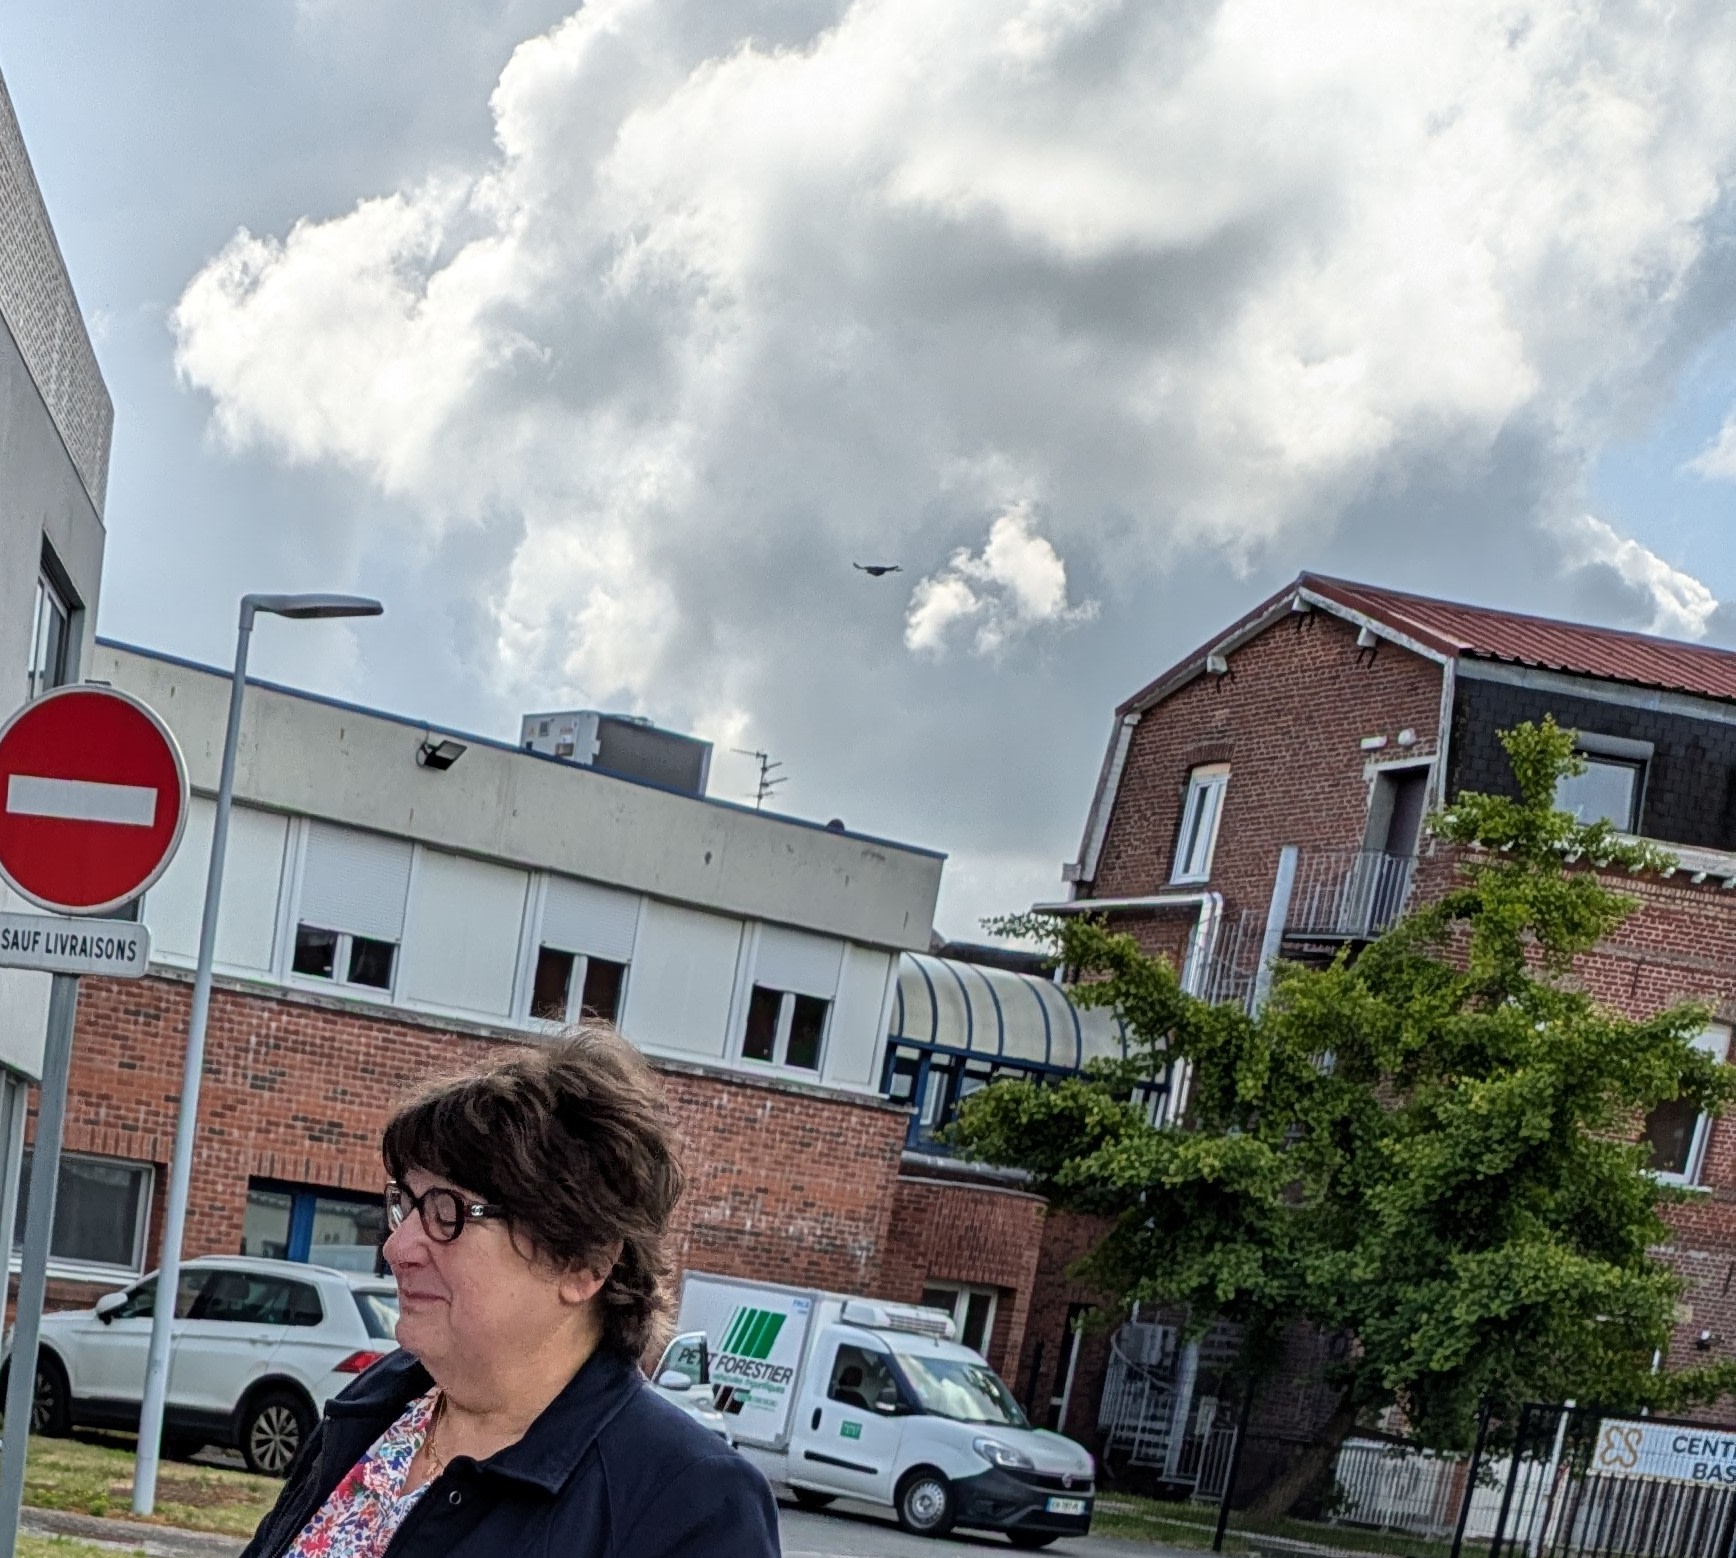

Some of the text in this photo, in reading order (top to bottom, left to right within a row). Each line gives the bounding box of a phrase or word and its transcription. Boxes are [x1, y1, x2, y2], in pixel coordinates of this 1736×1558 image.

[0, 927, 137, 962] SAUF LIVRAISONS
[715, 1355, 794, 1385] FORESTIER
[1672, 1435, 1736, 1460] CENT
